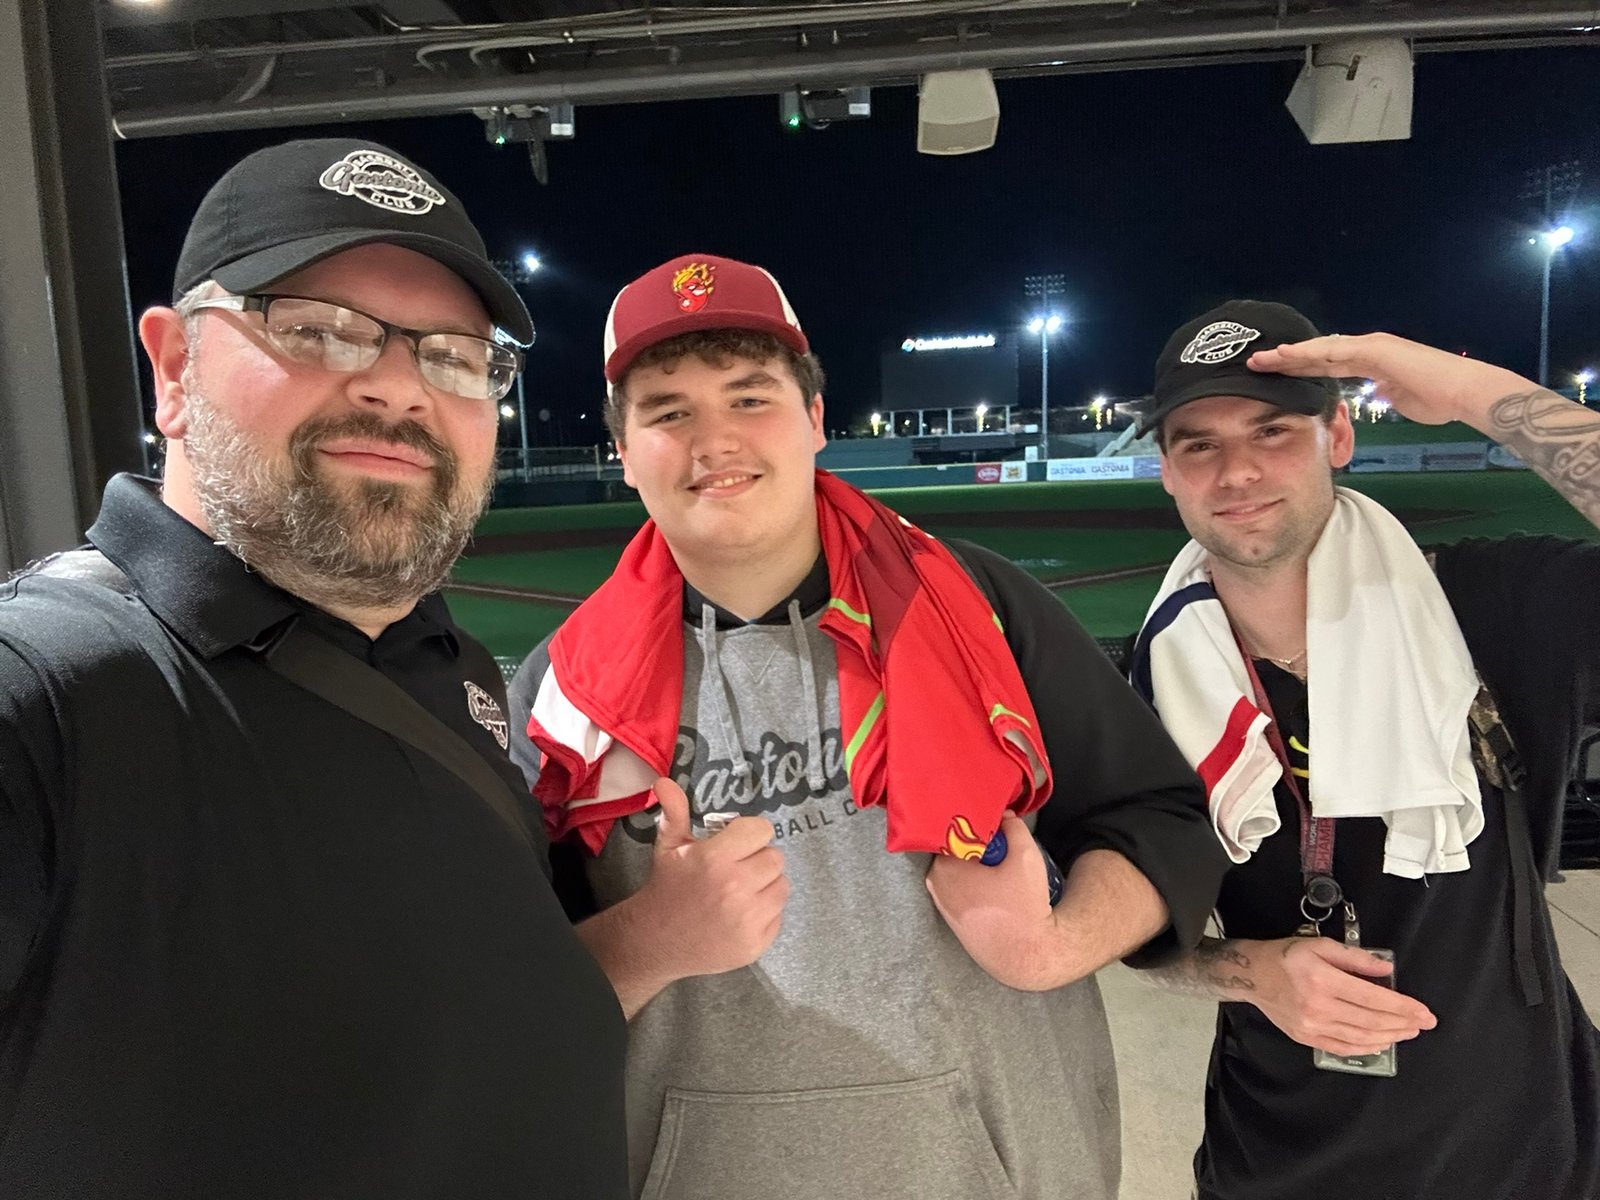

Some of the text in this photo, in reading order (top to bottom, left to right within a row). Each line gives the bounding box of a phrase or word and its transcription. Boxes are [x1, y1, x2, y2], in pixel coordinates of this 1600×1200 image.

[320, 160, 446, 205] Gastonia
[370, 191, 417, 209] CLUB
[1205, 347, 1234, 361] CLUB
[1091, 465, 1130, 473] GASTONIA
